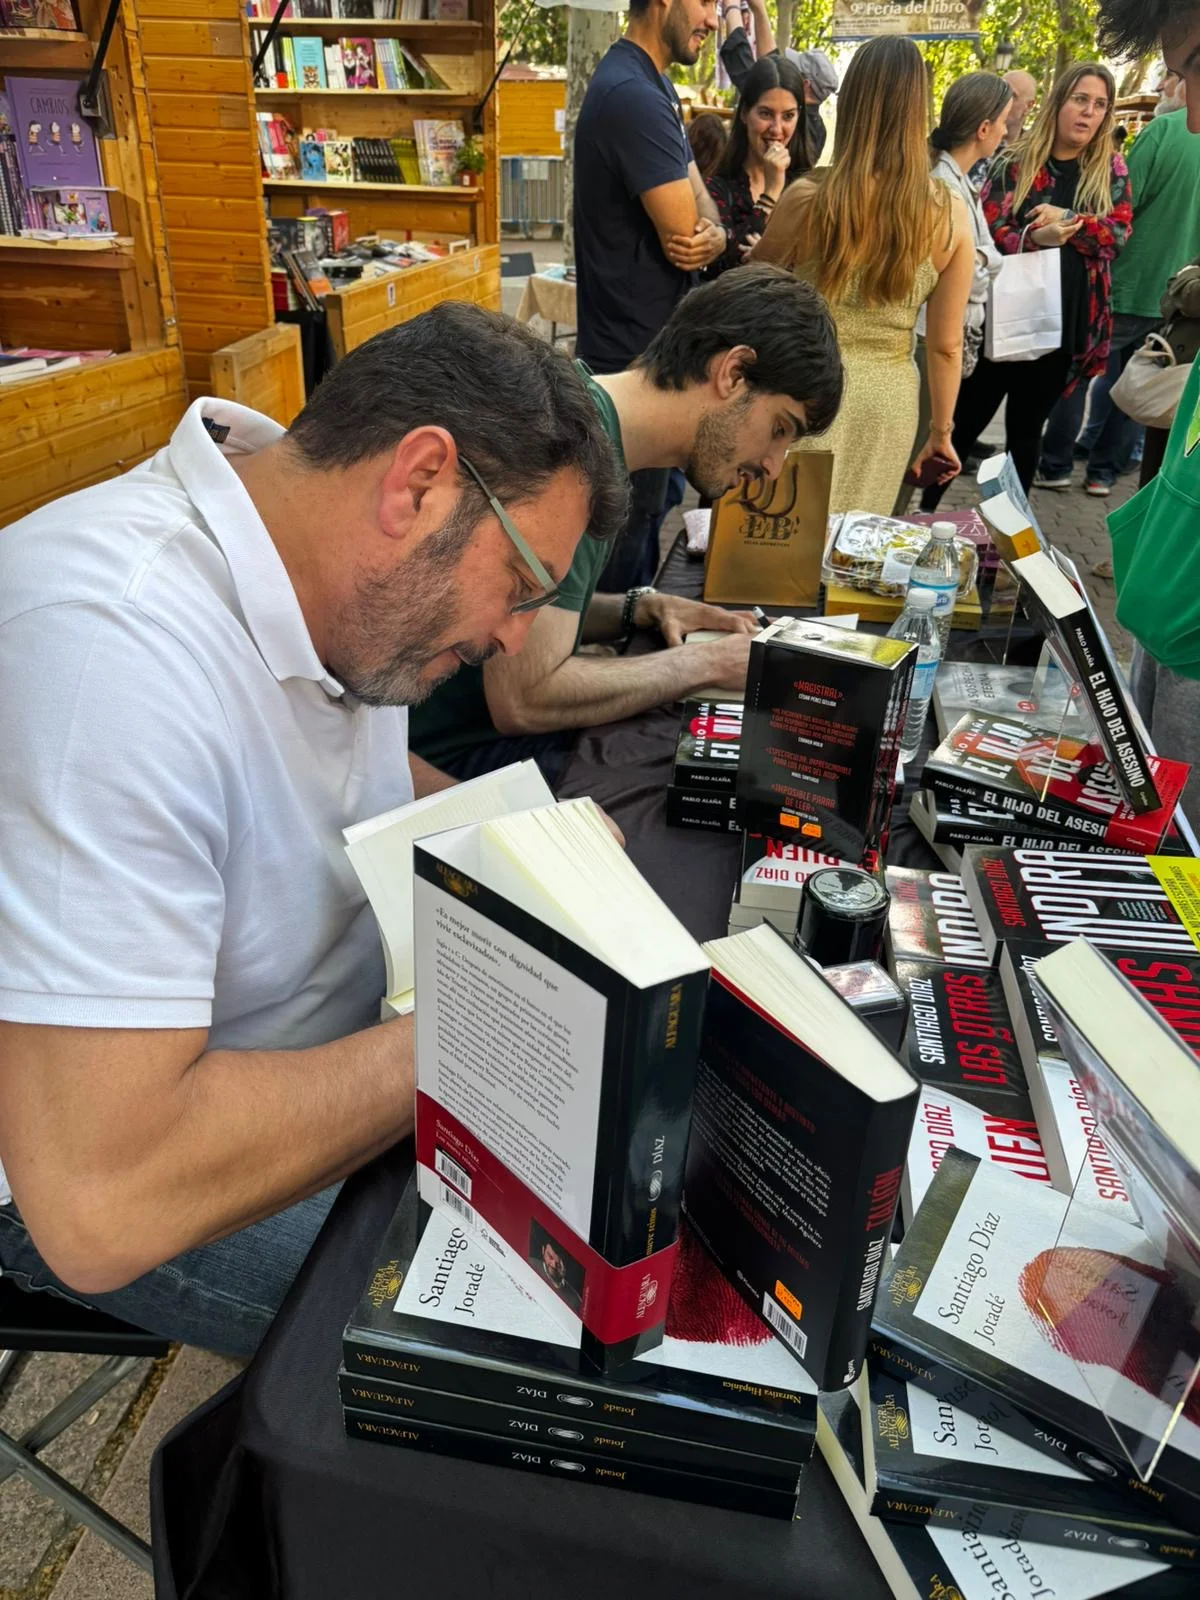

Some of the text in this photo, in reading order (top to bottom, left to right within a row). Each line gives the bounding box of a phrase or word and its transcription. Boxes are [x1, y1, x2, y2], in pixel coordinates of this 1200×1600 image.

[866, 2, 901, 15] Feria
[905, 0, 927, 14] del
[930, 0, 967, 13] libro
[1075, 627, 1087, 647] PABLO
[1082, 646, 1095, 669] ALAÑA
[979, 672, 995, 699] ETERNA
[1088, 671, 1107, 690] EL
[1095, 689, 1118, 718] HIJO
[693, 702, 710, 758] PABLO ALAÑA
[1107, 717, 1127, 742] DEL
[691, 774, 710, 782] PABLO
[961, 756, 1013, 779] EL
[1116, 743, 1147, 789] ASESINO
[682, 796, 737, 810] PABLO ALAÑA E
[934, 779, 1108, 839] PABLO ALAÑA EL HIJO DEL ASESI
[949, 832, 970, 840] PABLO
[1001, 835, 1017, 849] EL
[755, 865, 790, 882] DÍAZ
[988, 880, 1027, 928] SANTIAGO
[1013, 849, 1200, 953] INDIRA
[493, 945, 507, 957] con
[508, 953, 542, 980] dignidad
[543, 978, 558, 991] que
[906, 977, 934, 1002] DÍAZ
[943, 972, 1000, 1038] OTRAS
[913, 1002, 946, 1065] SANTIAGO
[953, 1041, 1009, 1085] LAS
[435, 1118, 464, 1148] Santiago
[920, 1102, 956, 1139] DÍAZ
[652, 1134, 665, 1165] DÍAZ
[983, 1113, 1052, 1182] UEN
[865, 1165, 904, 1232] TALIÓN
[418, 1226, 469, 1308] Santiago
[857, 1236, 886, 1312] SANTIAGO DÍAZ
[937, 1211, 1002, 1326] Santiago Díaz
[454, 1262, 486, 1317] Jotadé
[973, 1292, 1007, 1347] Jotadé
[871, 1342, 937, 1382] ALFAGUARA
[355, 1352, 637, 1417] ALFAGUARA DÍAZ Jotadé
[722, 1380, 802, 1404] Narrativa Hispánica
[351, 1387, 627, 1450] ALFAGUARA DÍAZ Jotadé
[879, 1400, 889, 1437] NEGRA
[1033, 1428, 1068, 1452] DÍAZ
[356, 1421, 627, 1481] ALFAGUARA DÍAZ Jotadé
[886, 1499, 1196, 1559] ALFAGUARA DÍAZ Jotadé
[1001, 1534, 1056, 1600] Jotad
